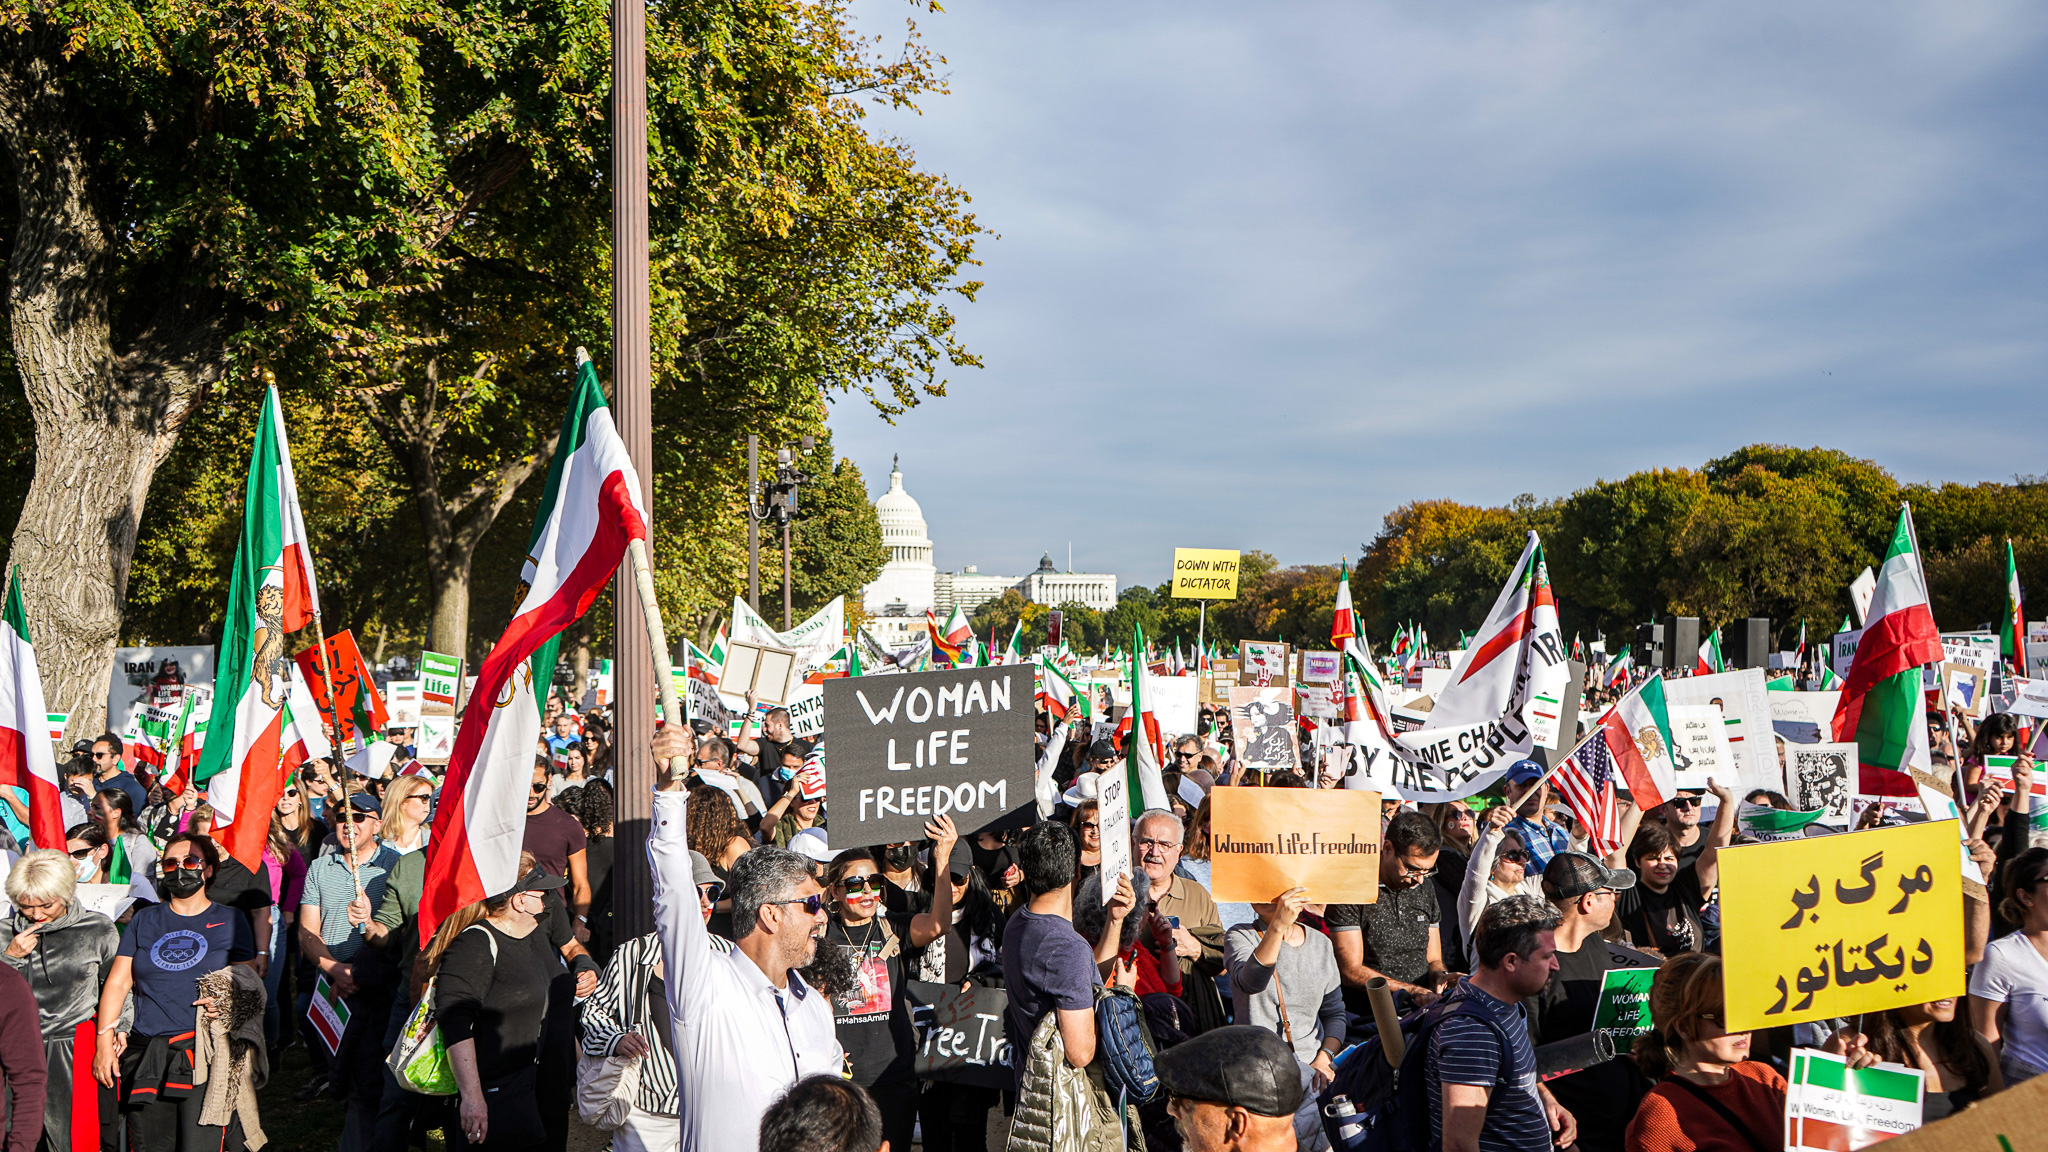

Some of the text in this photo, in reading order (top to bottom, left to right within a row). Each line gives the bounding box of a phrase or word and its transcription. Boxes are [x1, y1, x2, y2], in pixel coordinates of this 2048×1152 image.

[1177, 560, 1236, 572] DOWN WITH
[1180, 578, 1231, 591] DICTATOR
[1838, 642, 1857, 658] IRAN
[1943, 646, 1981, 657] TOP KILLING
[124, 661, 155, 673] IRAN
[1953, 657, 1975, 667] WOMEN
[424, 678, 451, 694] Life
[856, 676, 1011, 725] WOMAN
[147, 707, 179, 720] SHUTD
[798, 718, 812, 733] IN
[888, 729, 970, 771] LIFE
[1346, 743, 1381, 777] BY
[1388, 751, 1438, 793] THE
[859, 779, 1007, 822] FREEDOM
[1104, 780, 1121, 806] STOP
[1104, 806, 1124, 832] TALKING
[1112, 840, 1119, 853] TO
[1105, 854, 1128, 882] MULLAHS
[1780, 851, 1933, 930] مرگ بر
[155, 957, 198, 970] OLYMPIC TEAM
[1609, 951, 1640, 967] OP
[1764, 933, 1934, 1015] دیکتاتور
[1612, 992, 1650, 1005] WOMAN
[836, 1012, 890, 1025] #MahsaAmini
[1617, 1009, 1641, 1021] LIFE
[912, 1003, 1015, 1070] Free Ira
[1804, 1102, 1839, 1120] Woman,
[1866, 1114, 1916, 1132] Freedom
